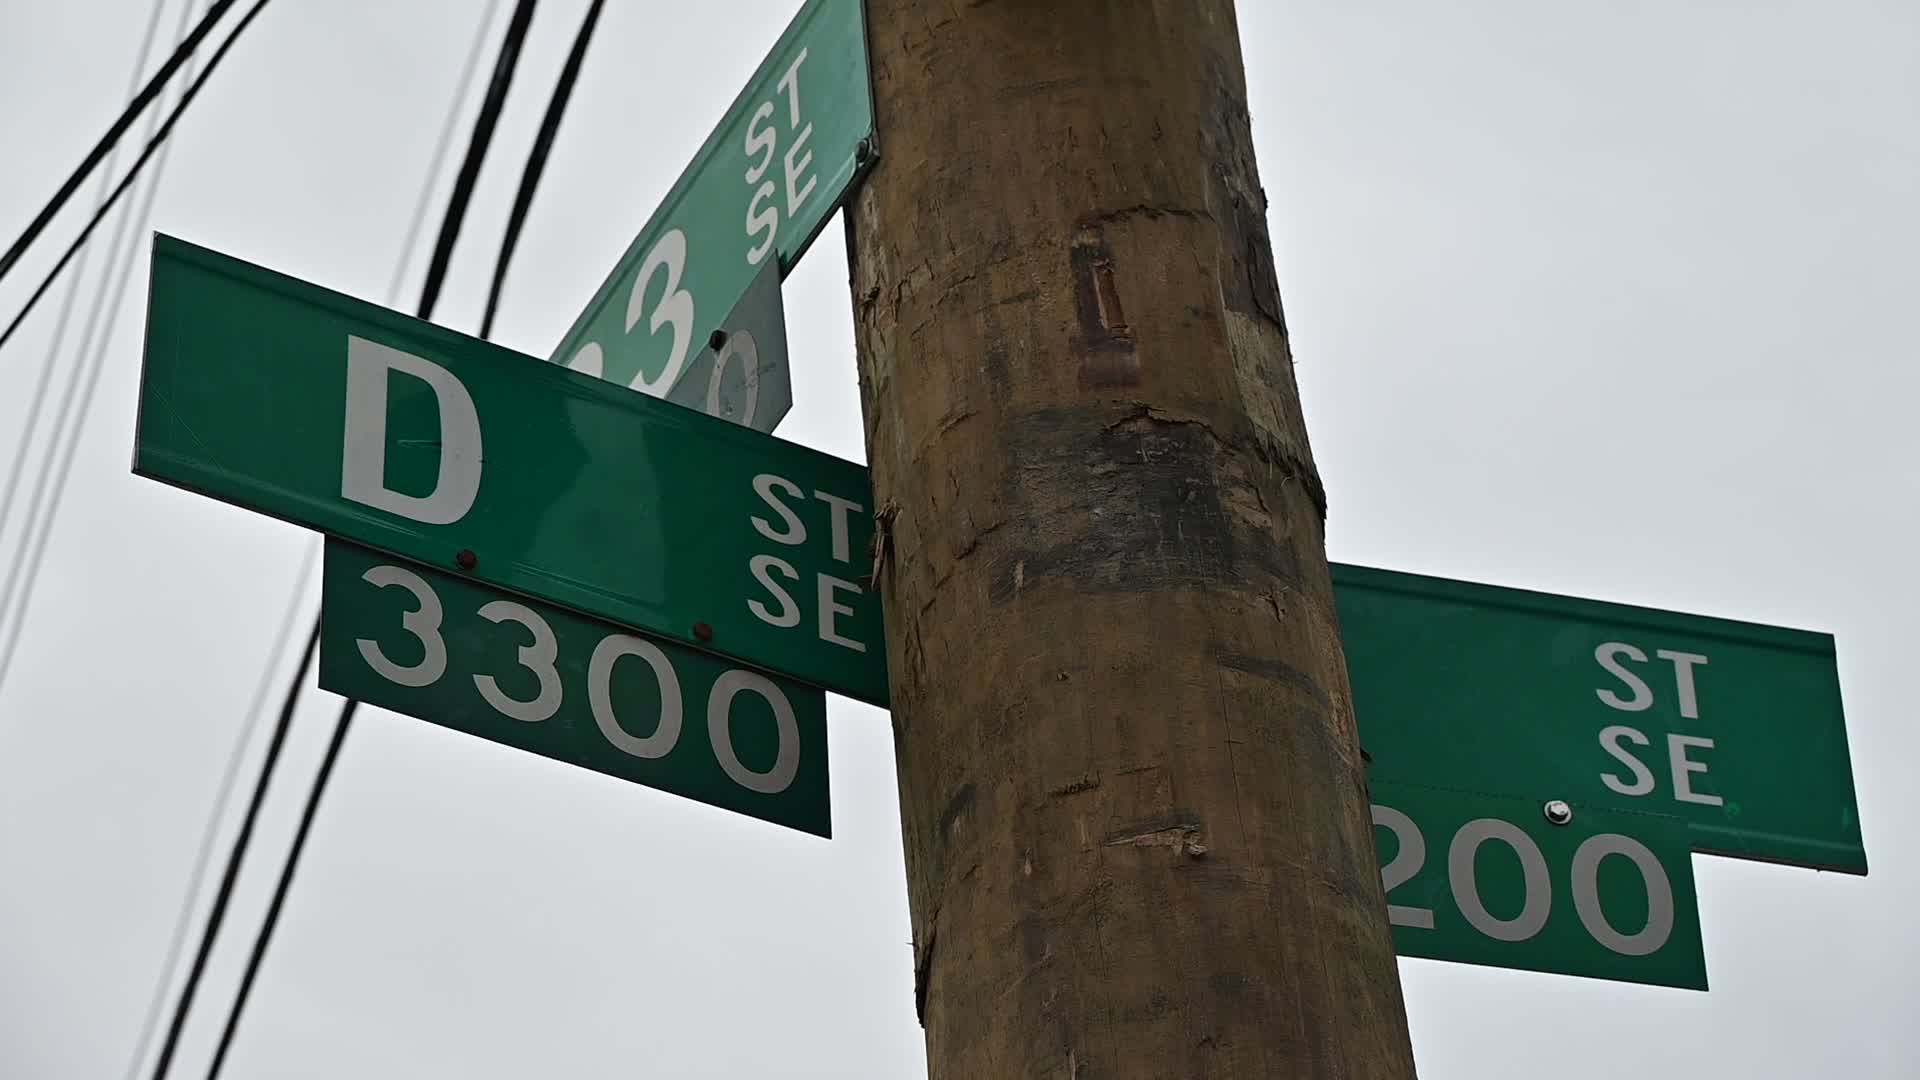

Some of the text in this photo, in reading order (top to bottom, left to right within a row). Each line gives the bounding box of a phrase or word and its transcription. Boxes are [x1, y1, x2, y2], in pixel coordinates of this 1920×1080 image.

[745, 47, 808, 184] ST
[746, 122, 817, 265] SE
[567, 228, 694, 399] 3
[340, 333, 483, 525] D
[750, 473, 863, 561] ST
[747, 554, 866, 653] SE
[355, 565, 800, 794] 3300
[1594, 642, 1708, 719] ST
[1598, 725, 1723, 806] SE
